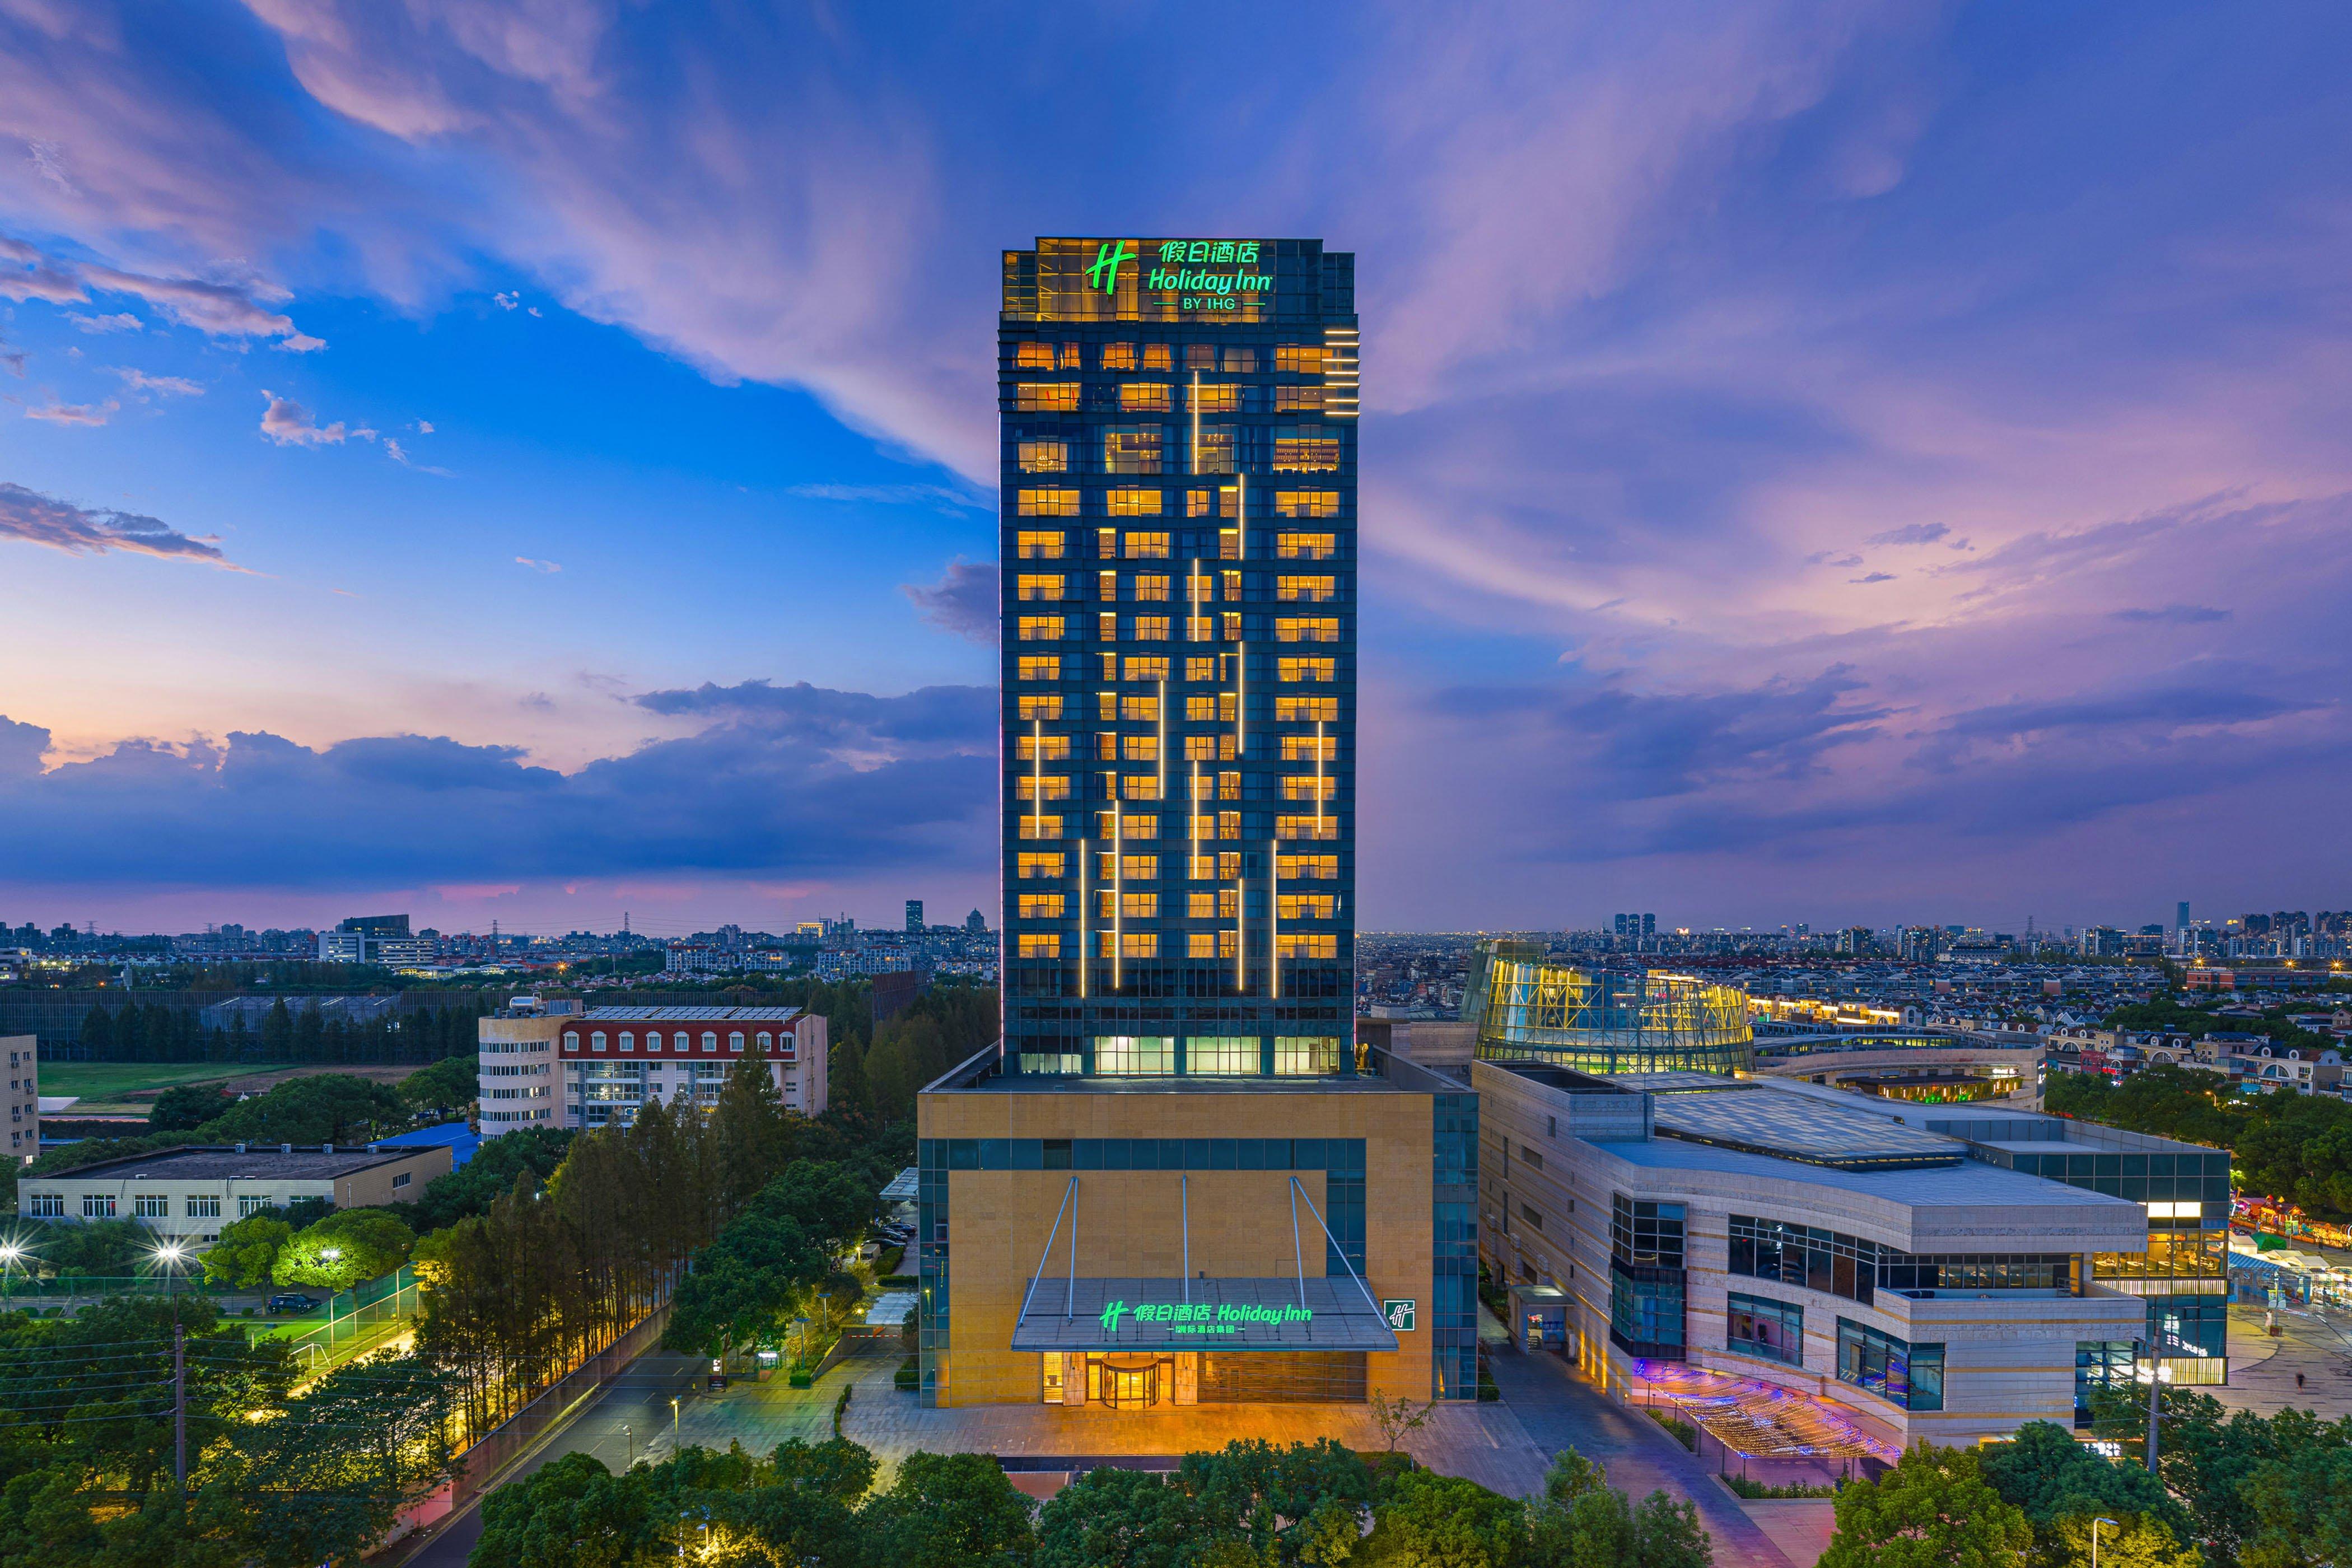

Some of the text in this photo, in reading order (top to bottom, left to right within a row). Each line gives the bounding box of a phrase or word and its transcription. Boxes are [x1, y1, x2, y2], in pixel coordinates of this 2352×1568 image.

[1158, 241, 1260, 263] 假日酒店
[1149, 268, 1271, 296] Holiday Inn
[1183, 298, 1235, 310] BY IHG
[1133, 1304, 1312, 1326] 假日酒店 Holiday Inn
[1175, 1325, 1235, 1333] 洲际酒店集团
